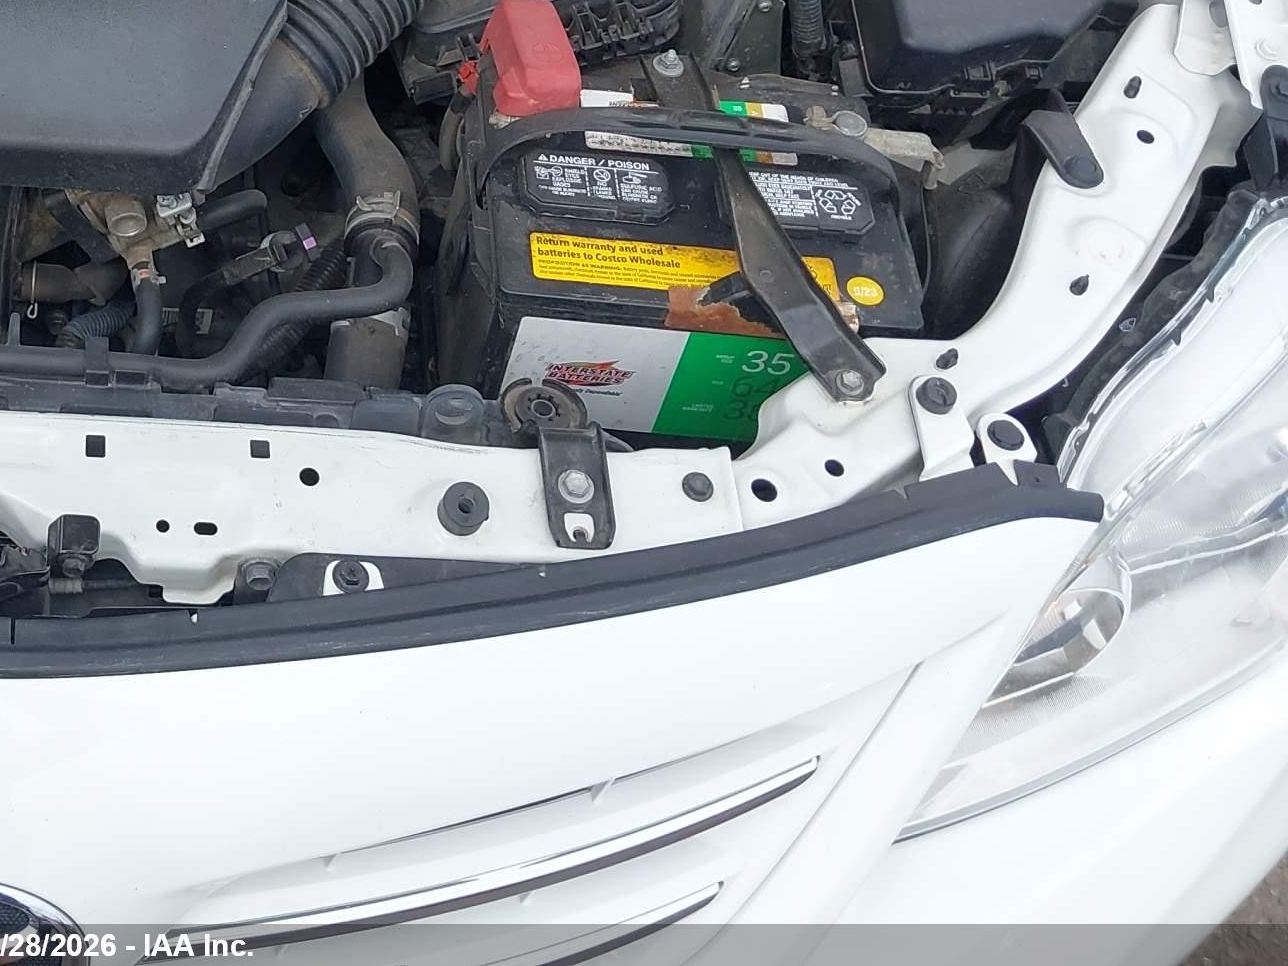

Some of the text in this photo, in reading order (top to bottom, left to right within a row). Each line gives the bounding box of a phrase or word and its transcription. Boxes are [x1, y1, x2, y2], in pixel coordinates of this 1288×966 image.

[549, 154, 596, 166] DANGER
[608, 159, 650, 171] POISON
[536, 235, 664, 256] Return warranty and used
[537, 247, 681, 269] batteries to Costco Wholesale
[546, 363, 632, 379] INTERSTATE
[741, 350, 795, 375] 35
[546, 372, 624, 385] BATTERIES
